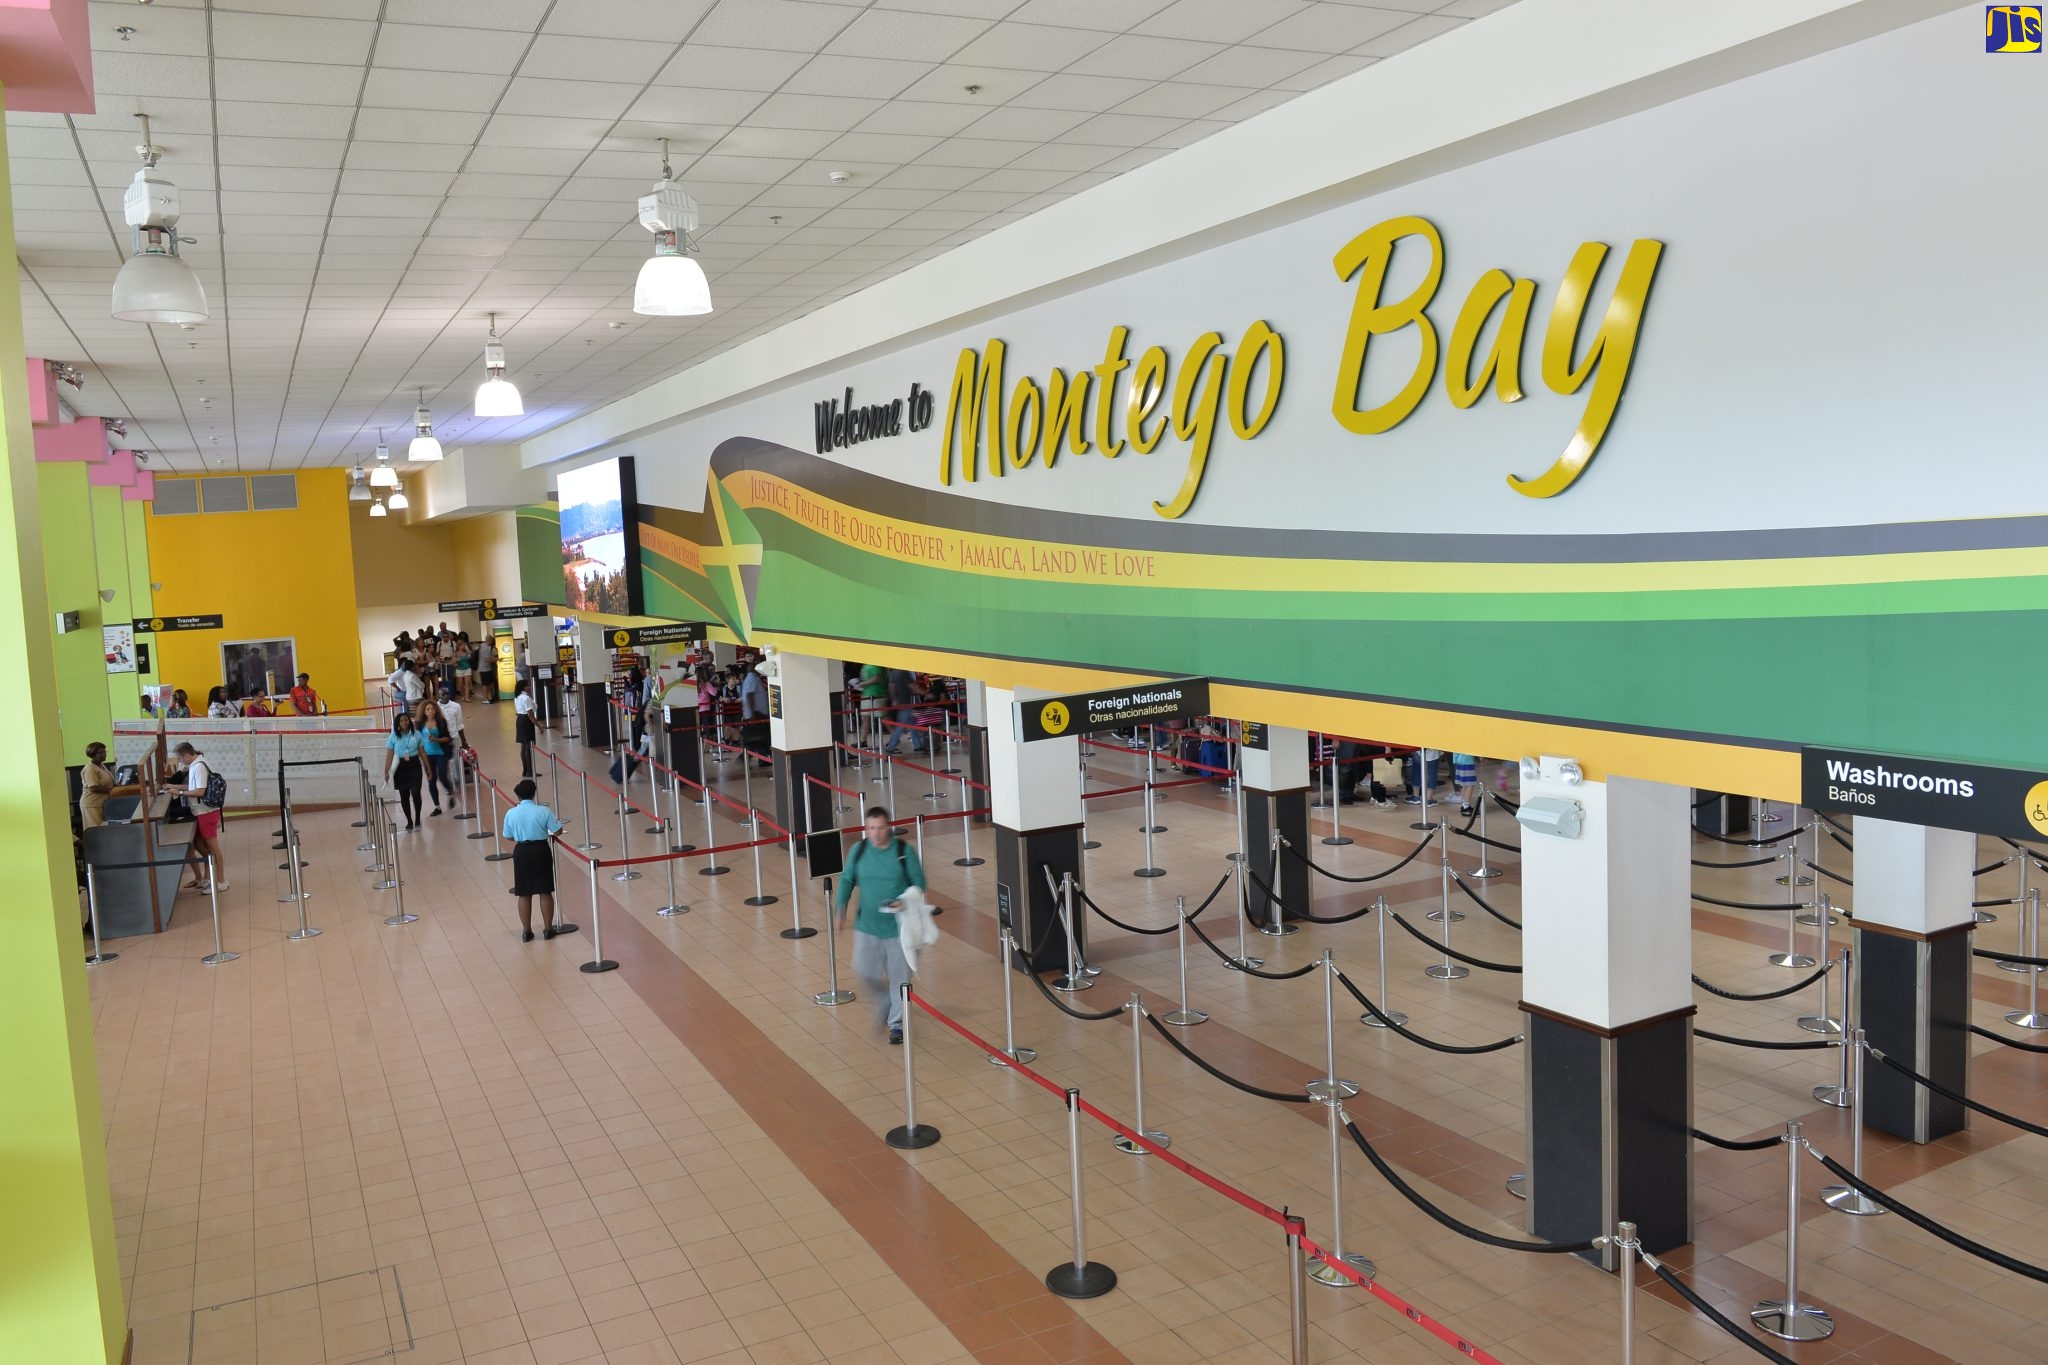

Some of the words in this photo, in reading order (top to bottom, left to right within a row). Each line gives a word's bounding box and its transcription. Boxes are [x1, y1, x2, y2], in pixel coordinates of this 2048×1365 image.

[815, 386, 903, 454] Welcome
[907, 383, 934, 432] to
[940, 319, 1285, 519] Montego
[1332, 215, 1664, 499] Bay
[751, 475, 791, 513] JUSTICE,
[794, 492, 829, 531] TRUTH
[834, 510, 847, 537] BE
[850, 517, 882, 549] OURS
[886, 526, 946, 562] FOREVER
[959, 539, 1026, 571] JAMAICA,
[1032, 546, 1077, 573] LAND
[1082, 550, 1107, 575] WE
[1114, 552, 1155, 577] LOVE
[664, 626, 691, 634] Nationals
[1088, 697, 1130, 711] Foreign
[1132, 689, 1182, 705] Nationals
[1089, 712, 1114, 723] Otras
[1116, 703, 1178, 720] nacionalidades
[1826, 759, 1974, 797] Washrooms
[1829, 786, 1876, 805] Baños
